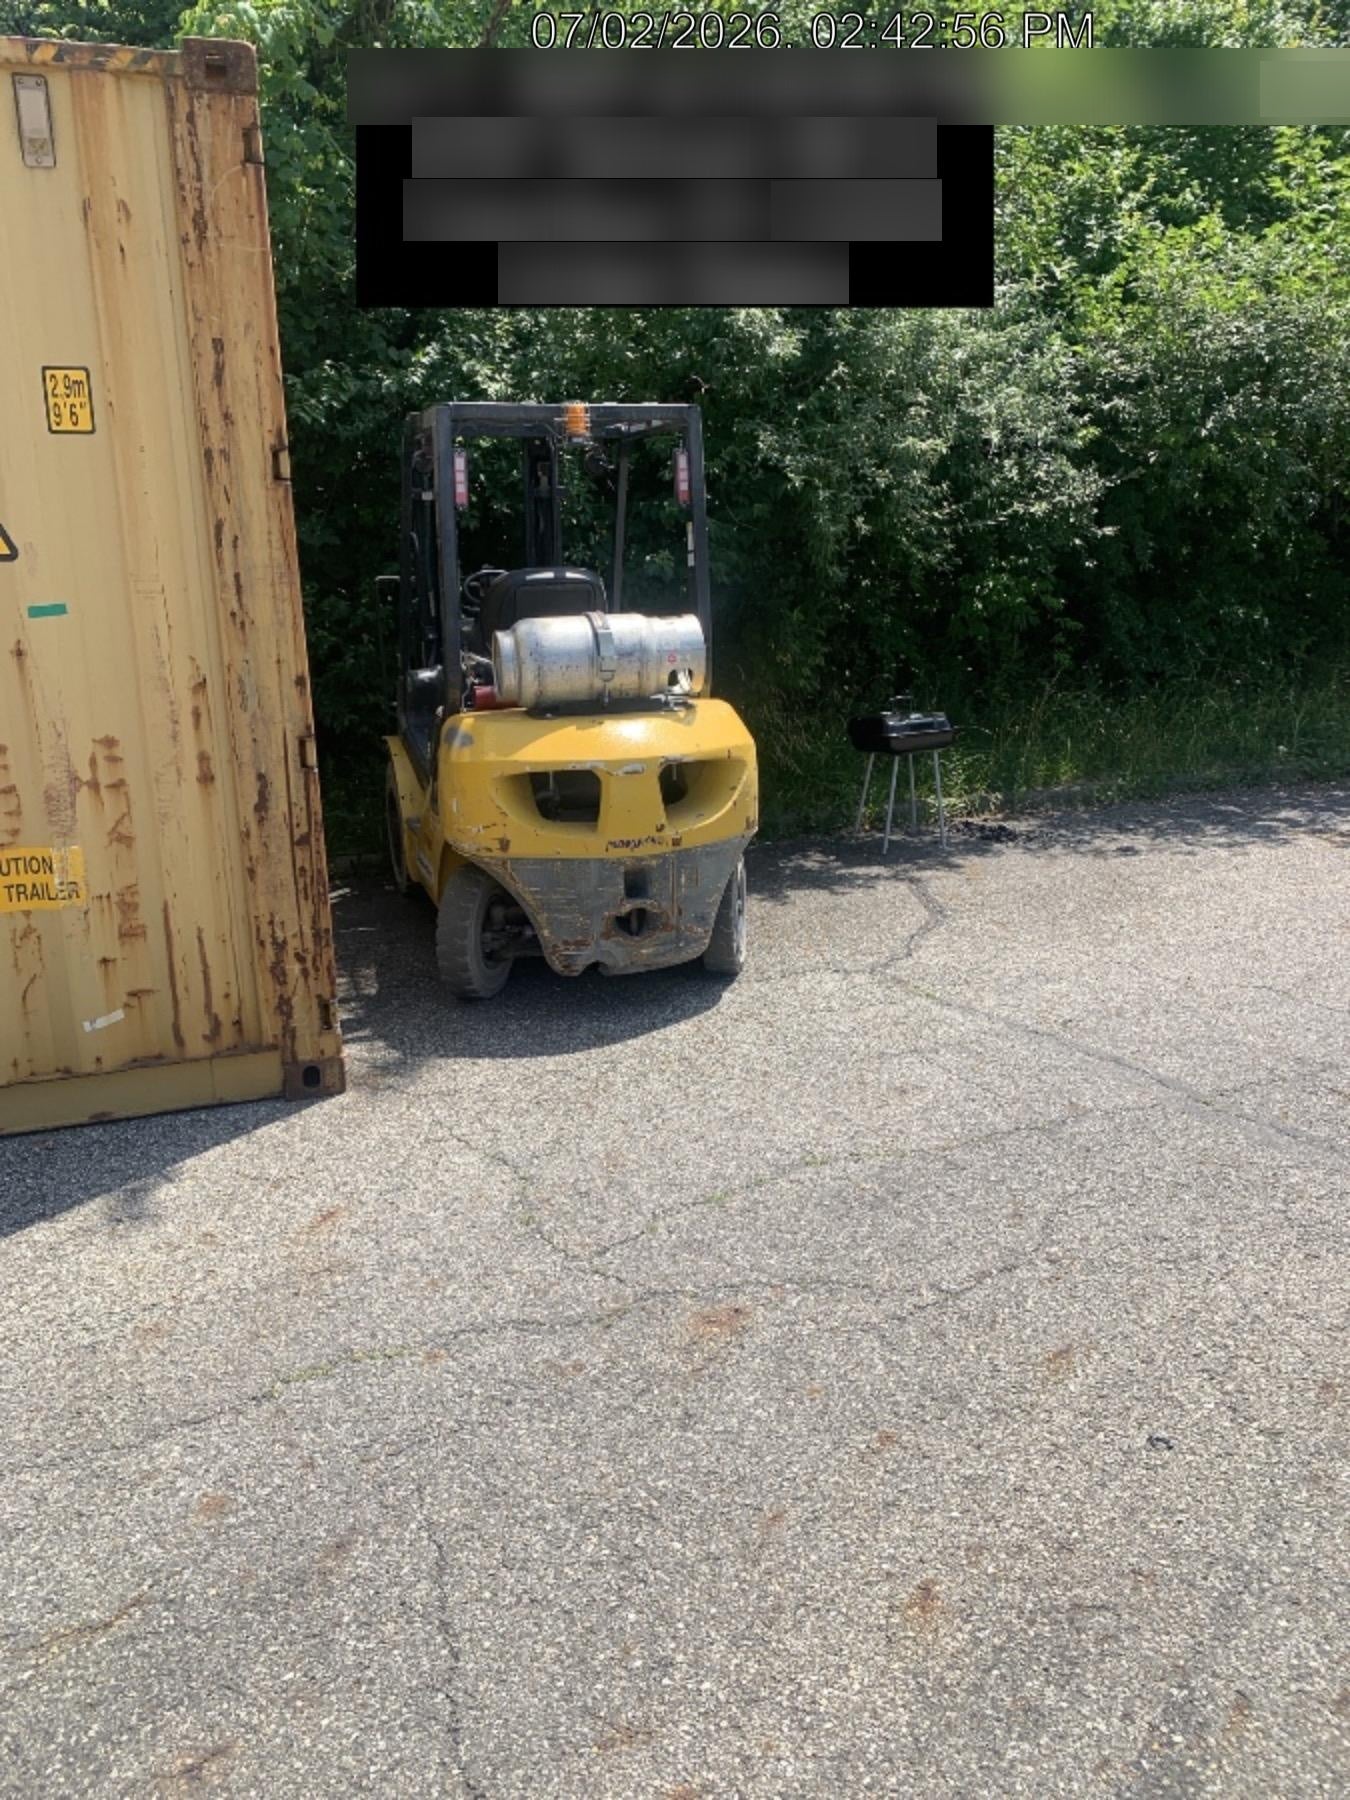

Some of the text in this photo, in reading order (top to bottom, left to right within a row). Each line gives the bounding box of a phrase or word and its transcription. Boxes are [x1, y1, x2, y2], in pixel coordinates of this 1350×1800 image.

[49, 373, 86, 399] 2.9m
[0, 855, 54, 877] UTION
[3, 881, 81, 903] TRAILER
